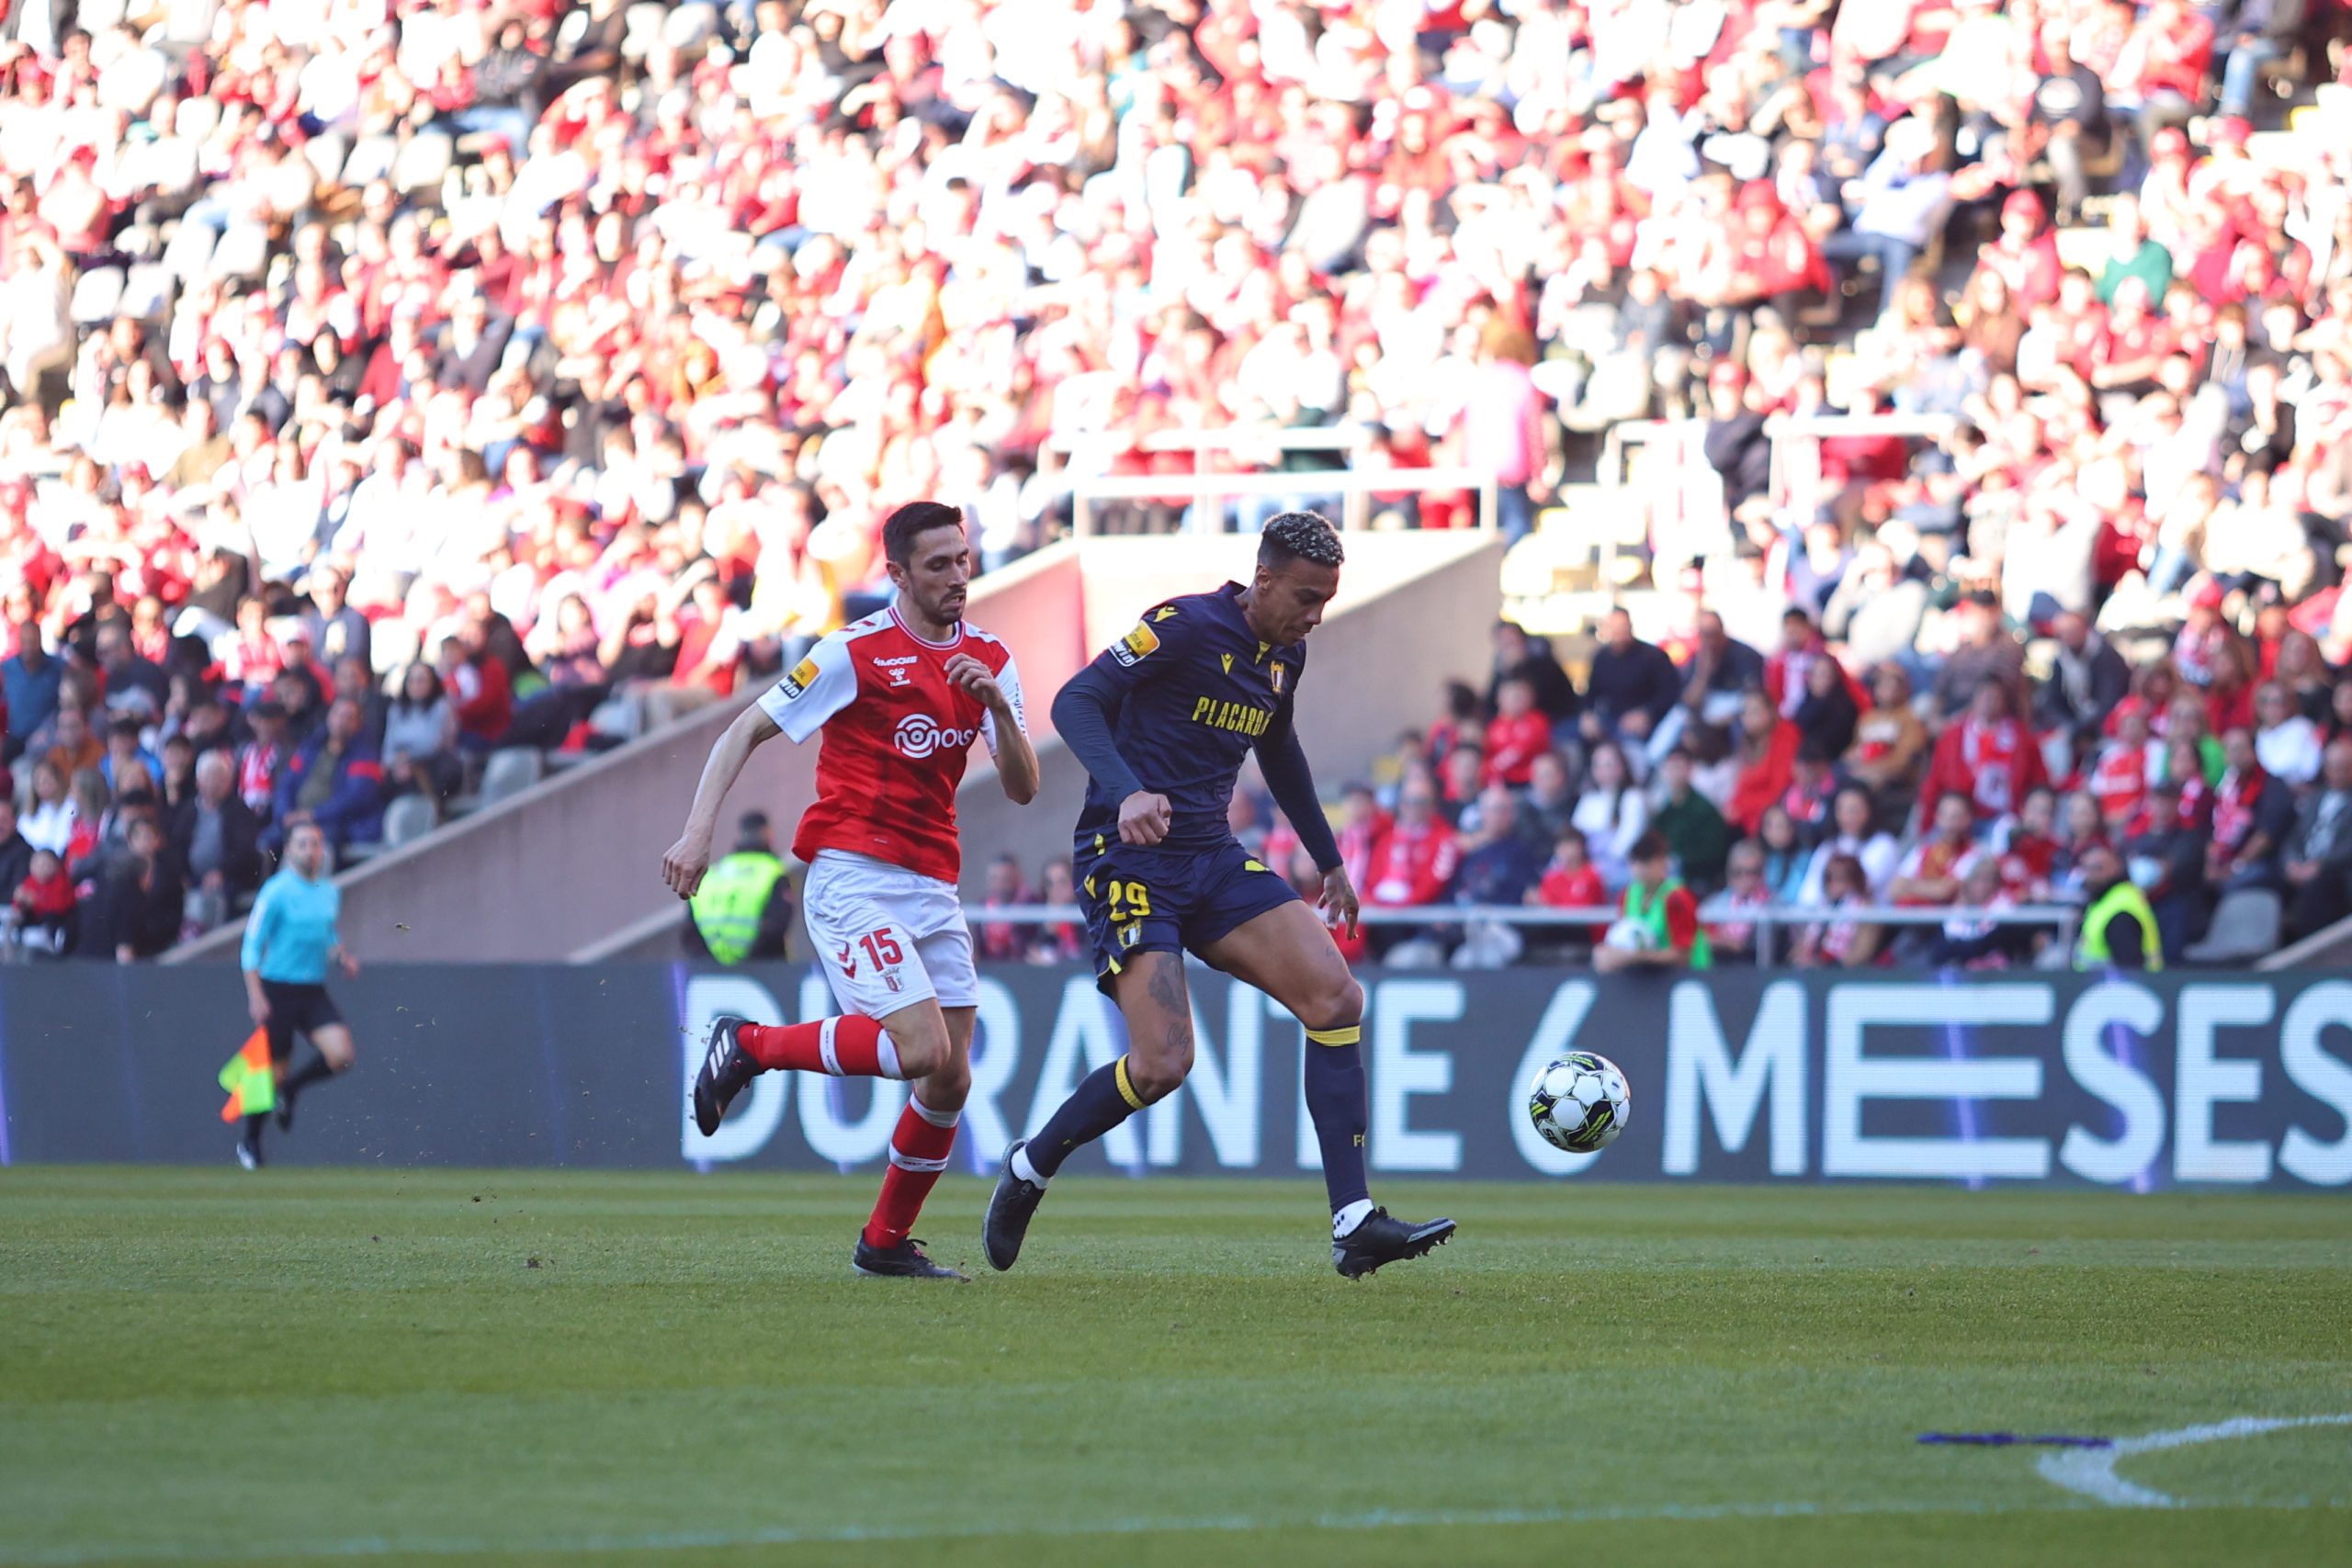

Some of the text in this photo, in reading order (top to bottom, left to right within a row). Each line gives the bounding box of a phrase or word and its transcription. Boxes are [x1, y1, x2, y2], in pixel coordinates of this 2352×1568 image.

[1109, 880, 1150, 921] 29
[859, 928, 903, 972] 15
[681, 976, 2352, 1185] DURANTE 6 MESES
